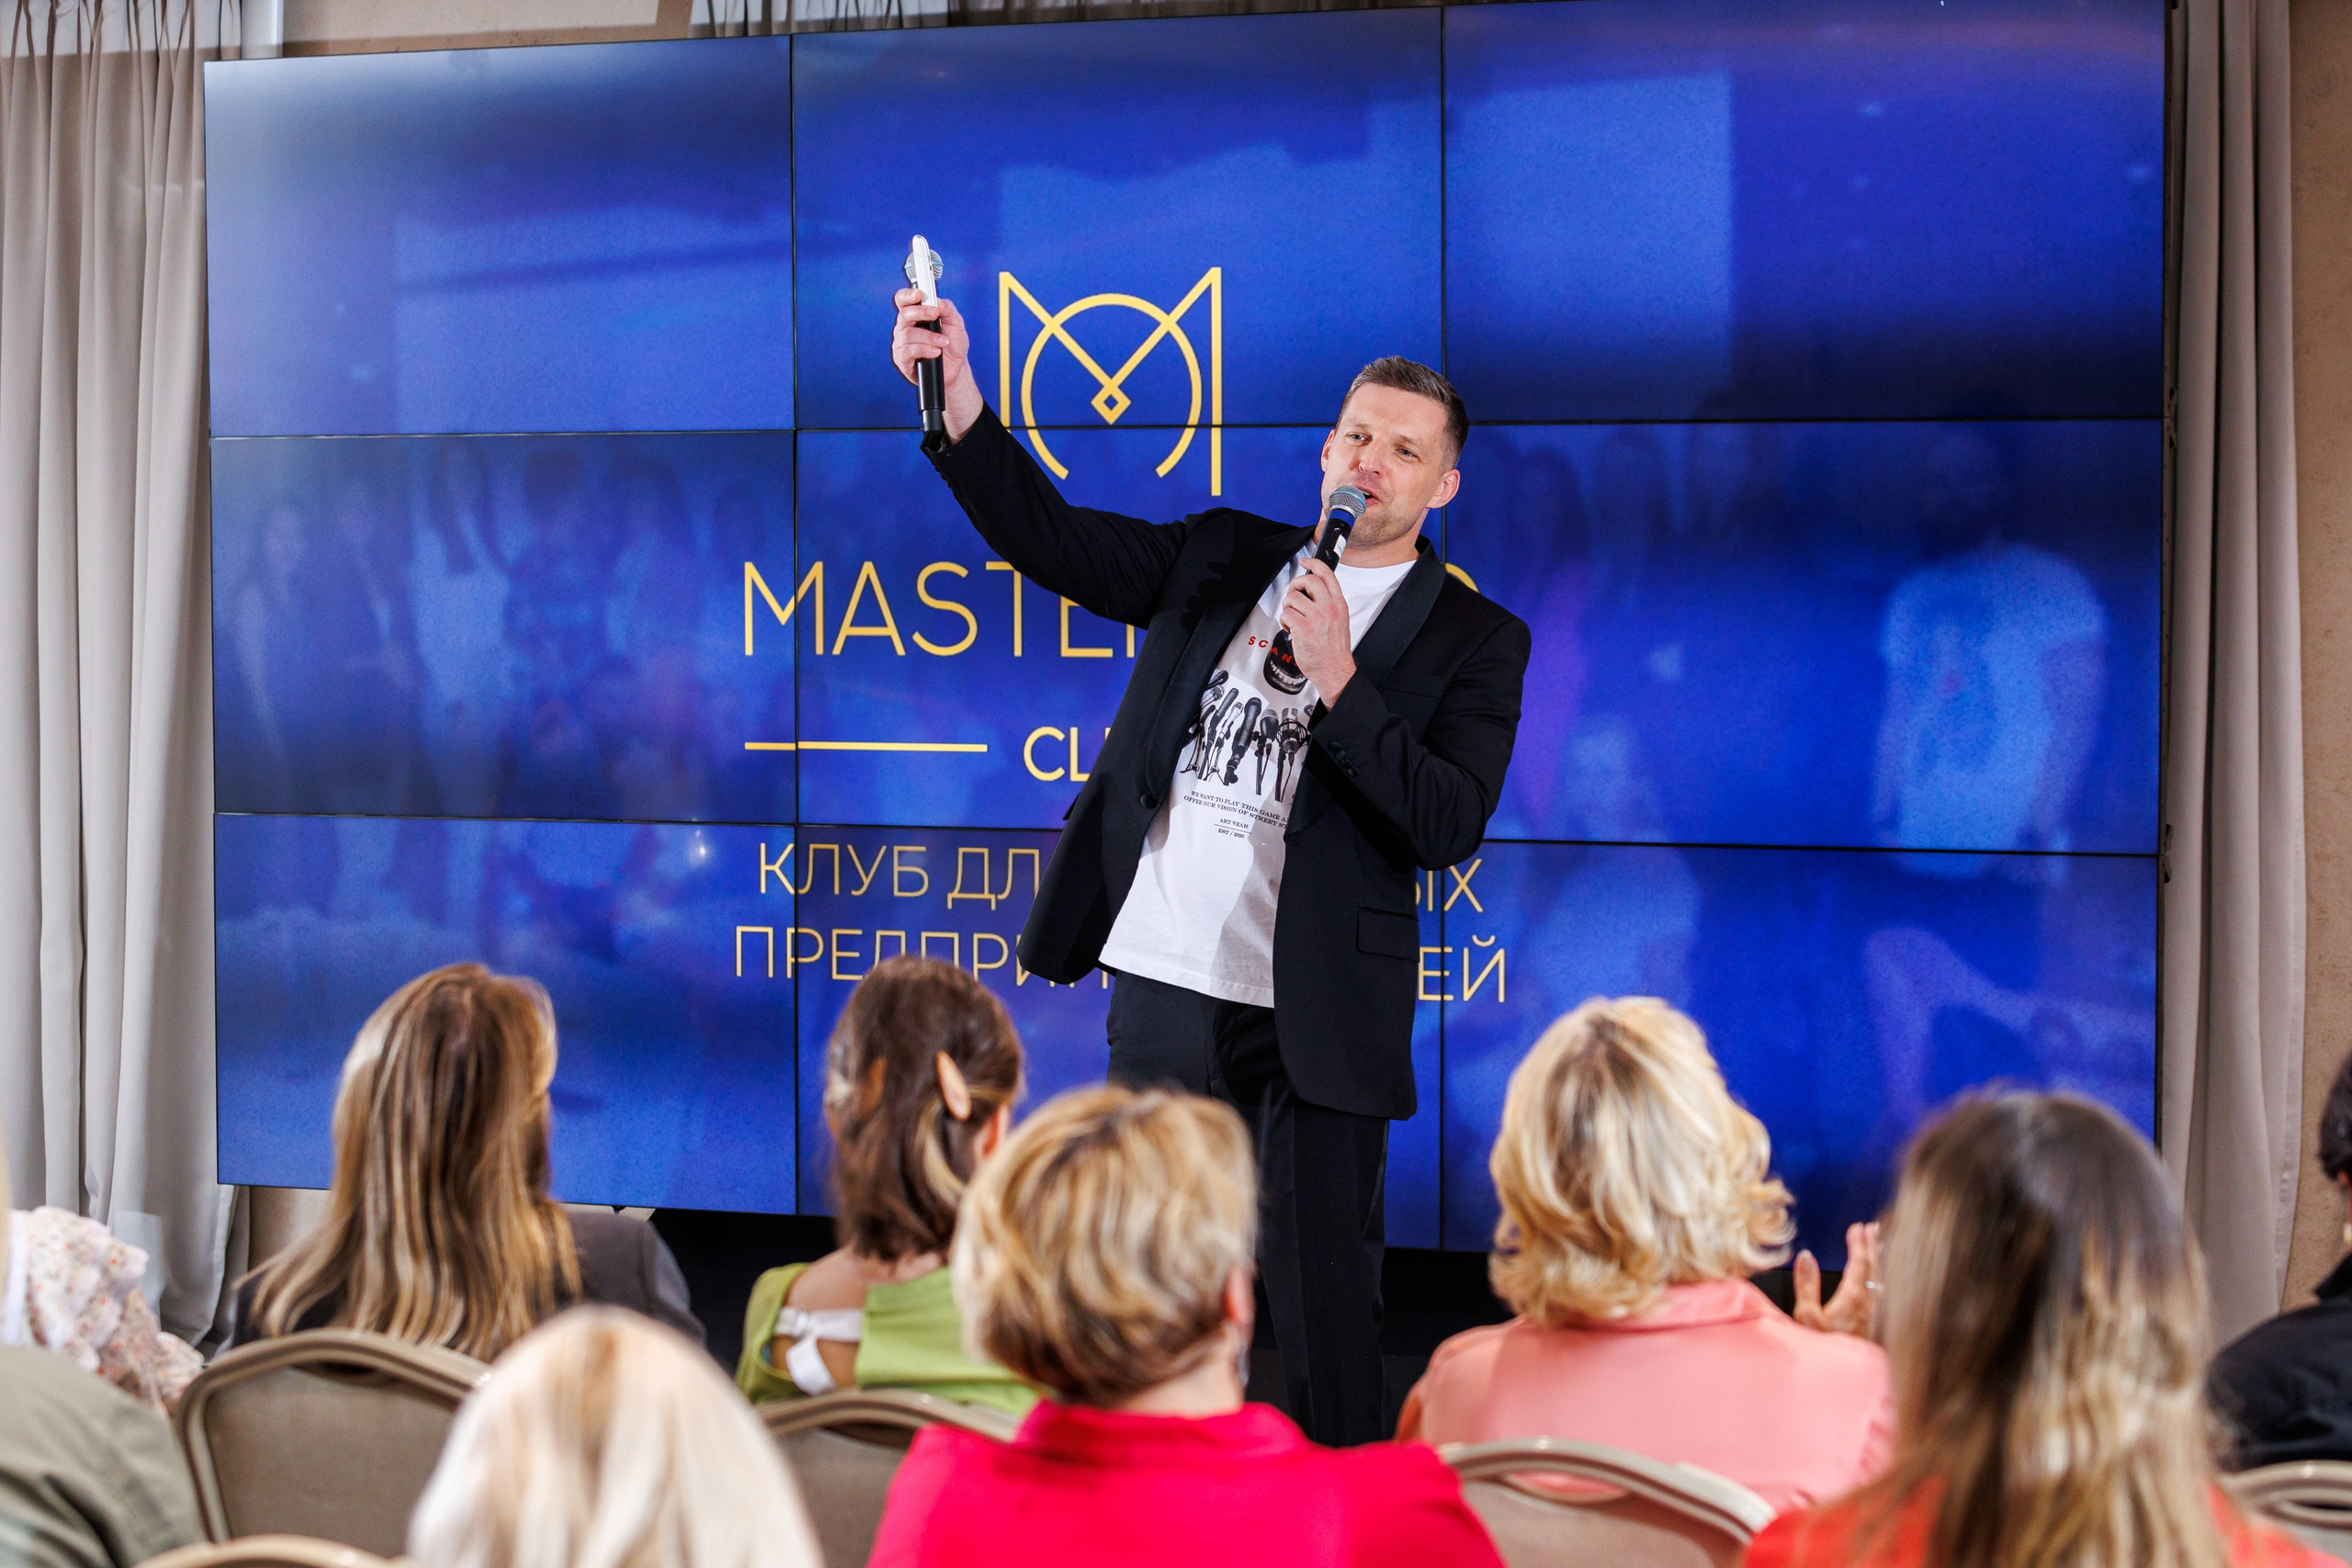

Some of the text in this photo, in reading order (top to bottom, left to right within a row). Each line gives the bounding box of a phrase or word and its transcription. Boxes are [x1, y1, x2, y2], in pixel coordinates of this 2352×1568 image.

[1248, 636, 1297, 667] SCAN
[1023, 726, 1112, 783] CL
[1183, 795, 1203, 805] OFFER
[1216, 803, 1238, 813] VISION
[1249, 813, 1278, 827] STREET
[1200, 793, 1215, 801] WANT
[1224, 798, 1240, 807] PLAY
[1240, 802, 1259, 813] THIS
[1260, 809, 1281, 820] GAME
[1232, 820, 1249, 829] WEAR
[759, 841, 930, 897] КЛУБ
[946, 846, 1041, 911] ДЛ
